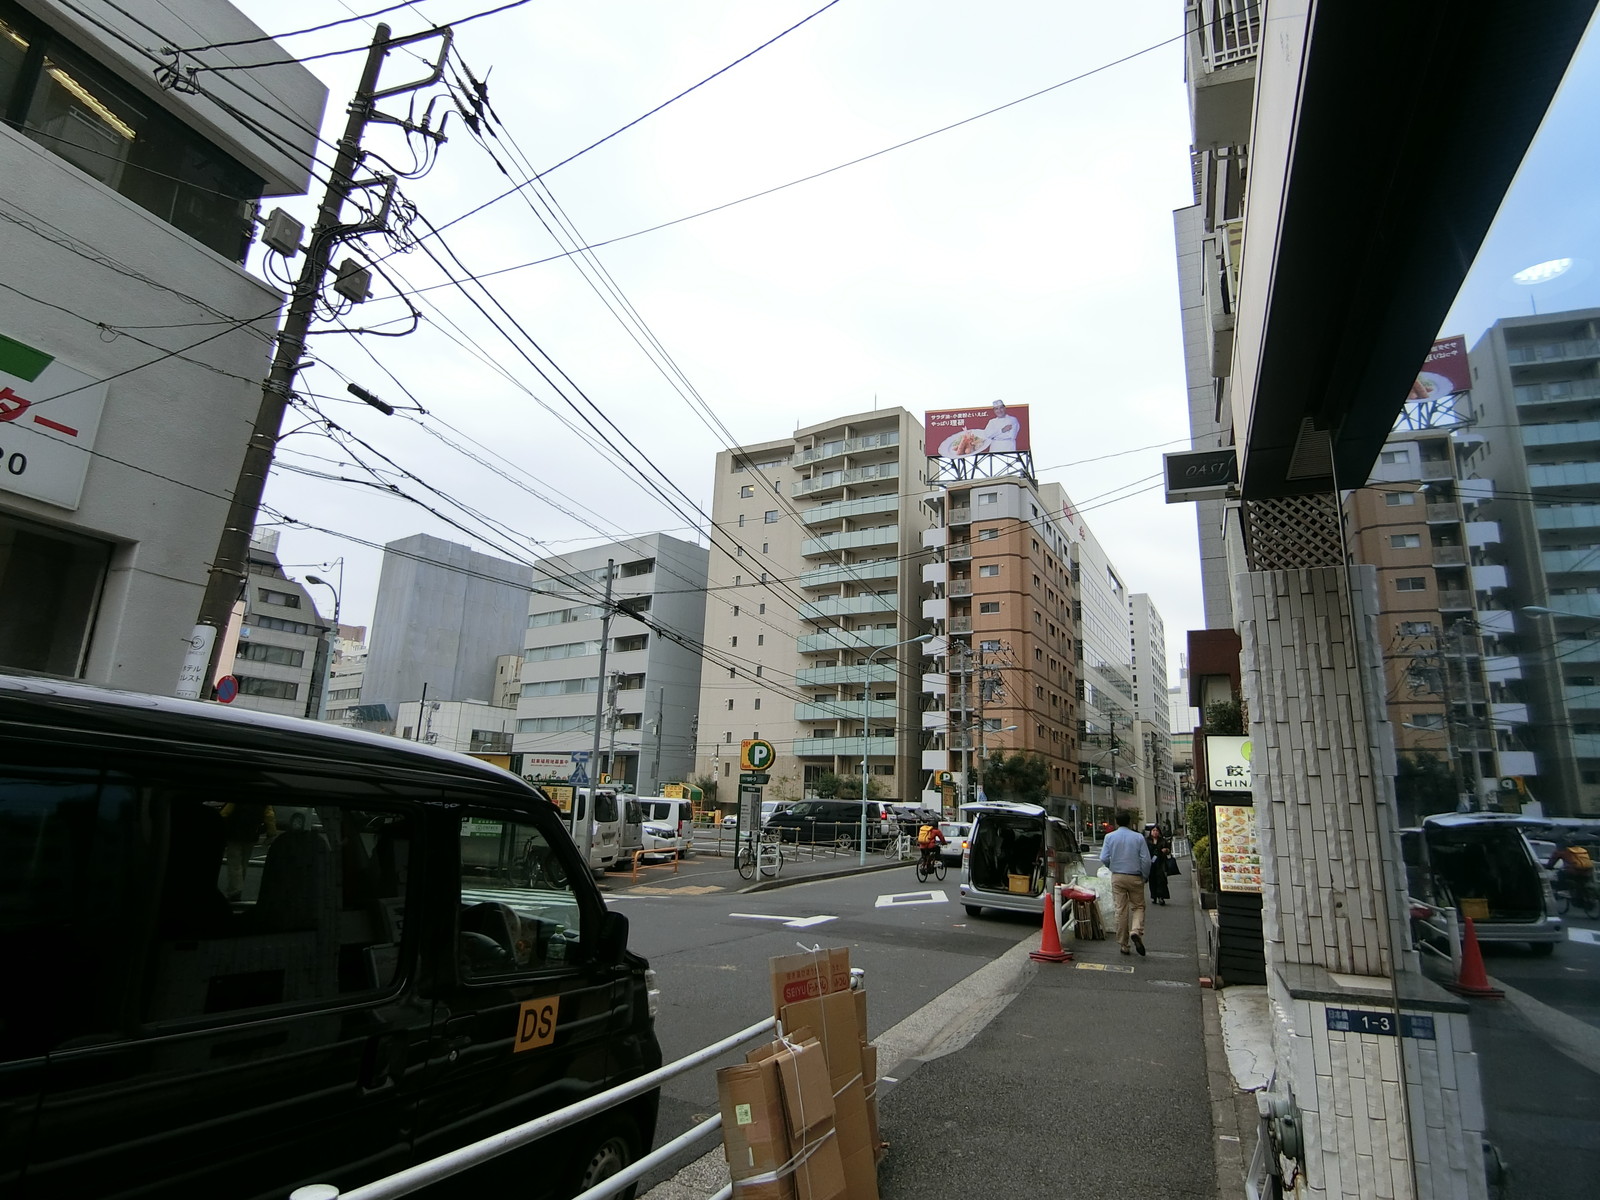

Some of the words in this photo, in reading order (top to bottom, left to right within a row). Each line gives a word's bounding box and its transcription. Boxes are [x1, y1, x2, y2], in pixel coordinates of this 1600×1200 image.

[786, 984, 806, 998] SEIYU
[520, 1005, 553, 1043] DS
[1361, 1016, 1390, 1031] 1-3
